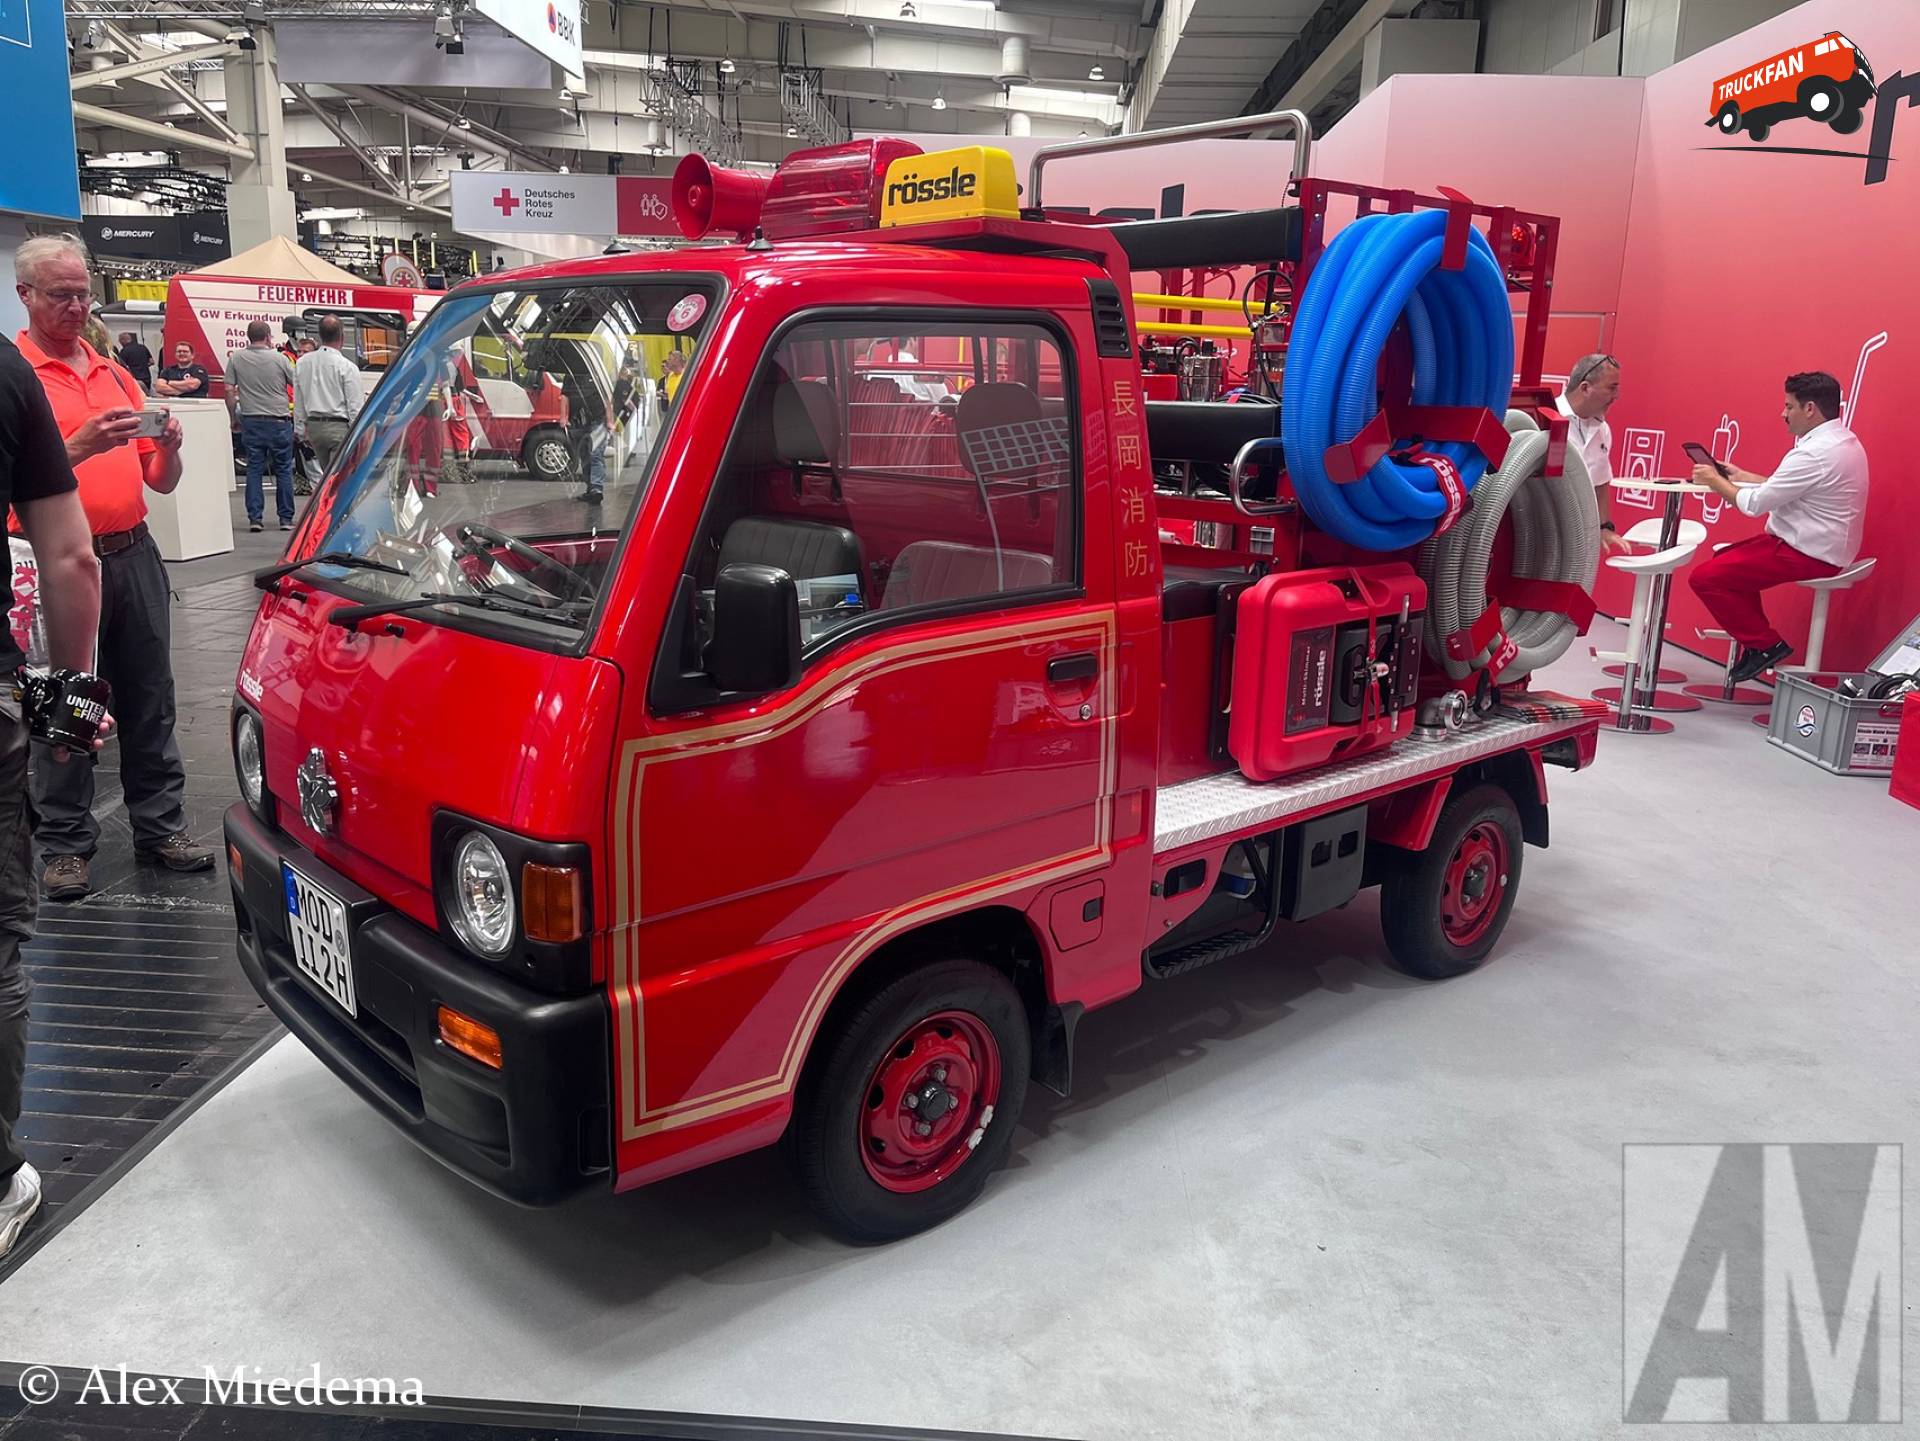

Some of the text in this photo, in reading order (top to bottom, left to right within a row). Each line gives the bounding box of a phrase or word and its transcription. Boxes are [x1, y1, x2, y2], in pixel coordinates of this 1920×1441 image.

[557, 11, 575, 46] BBK
[887, 166, 976, 206] rössle
[524, 188, 576, 199] Deutsches
[525, 199, 553, 208] Rotes
[525, 209, 553, 218] Kreuz
[113, 230, 155, 238] MERCURY
[200, 234, 223, 245] MERCURY
[258, 285, 347, 304] FEUERWEHR
[200, 309, 284, 323] GW Erkundun
[225, 328, 247, 337] Ato
[1313, 650, 1327, 707] rössle
[66, 694, 105, 715] UNITED
[297, 925, 350, 1004] 112H
